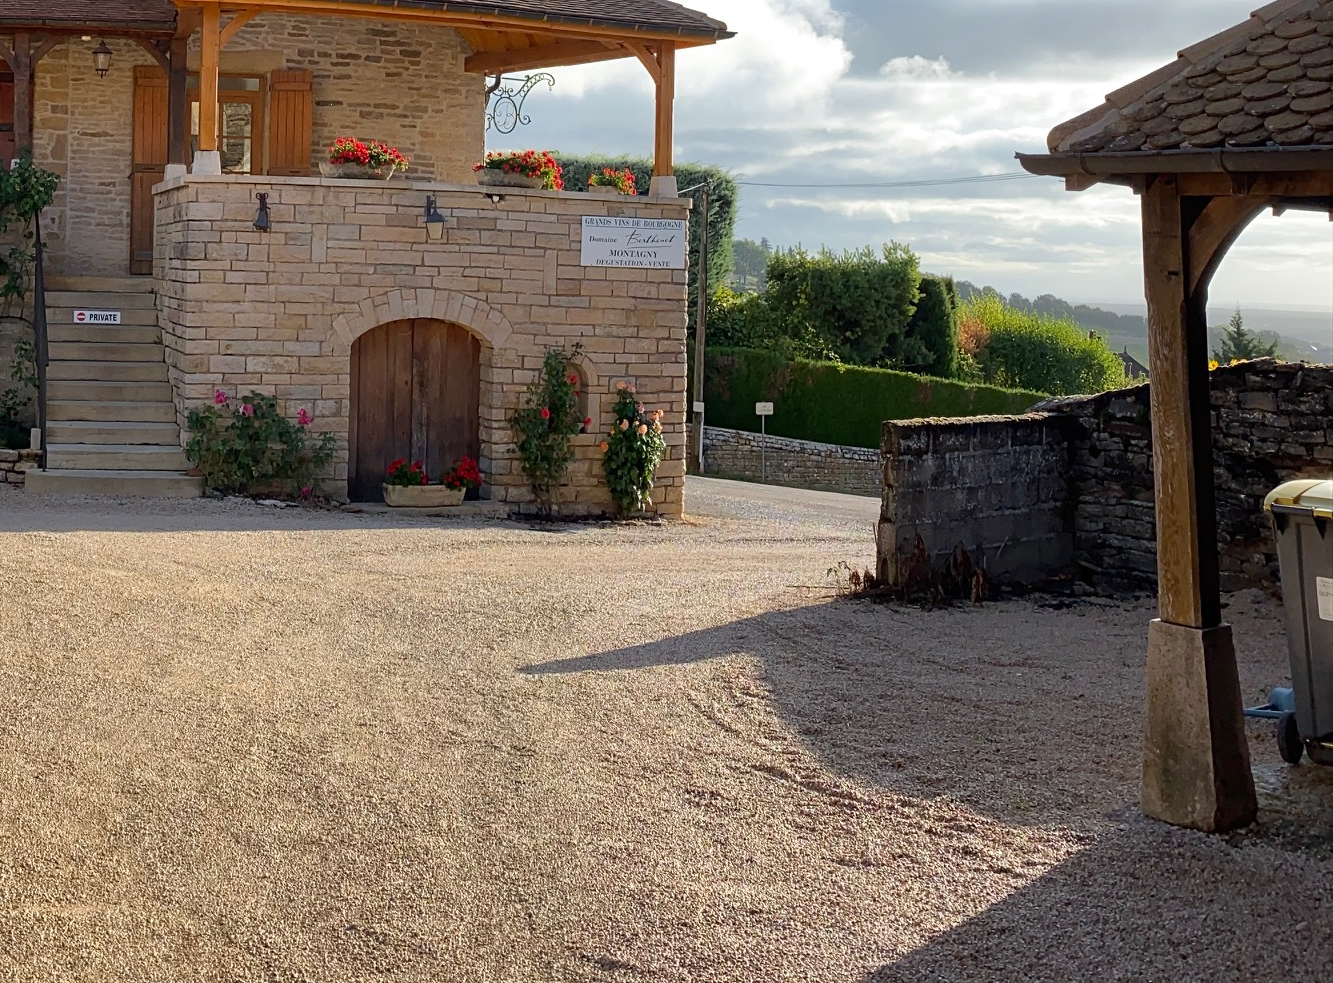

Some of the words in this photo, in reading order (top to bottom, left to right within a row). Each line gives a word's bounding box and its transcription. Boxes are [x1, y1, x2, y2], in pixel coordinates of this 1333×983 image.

[585, 218, 611, 226] GRANDS
[632, 219, 642, 227] DE
[644, 220, 683, 228] BOURGOGNE
[609, 250, 658, 258] MONTAGNY
[89, 313, 118, 322] PRIVATE
